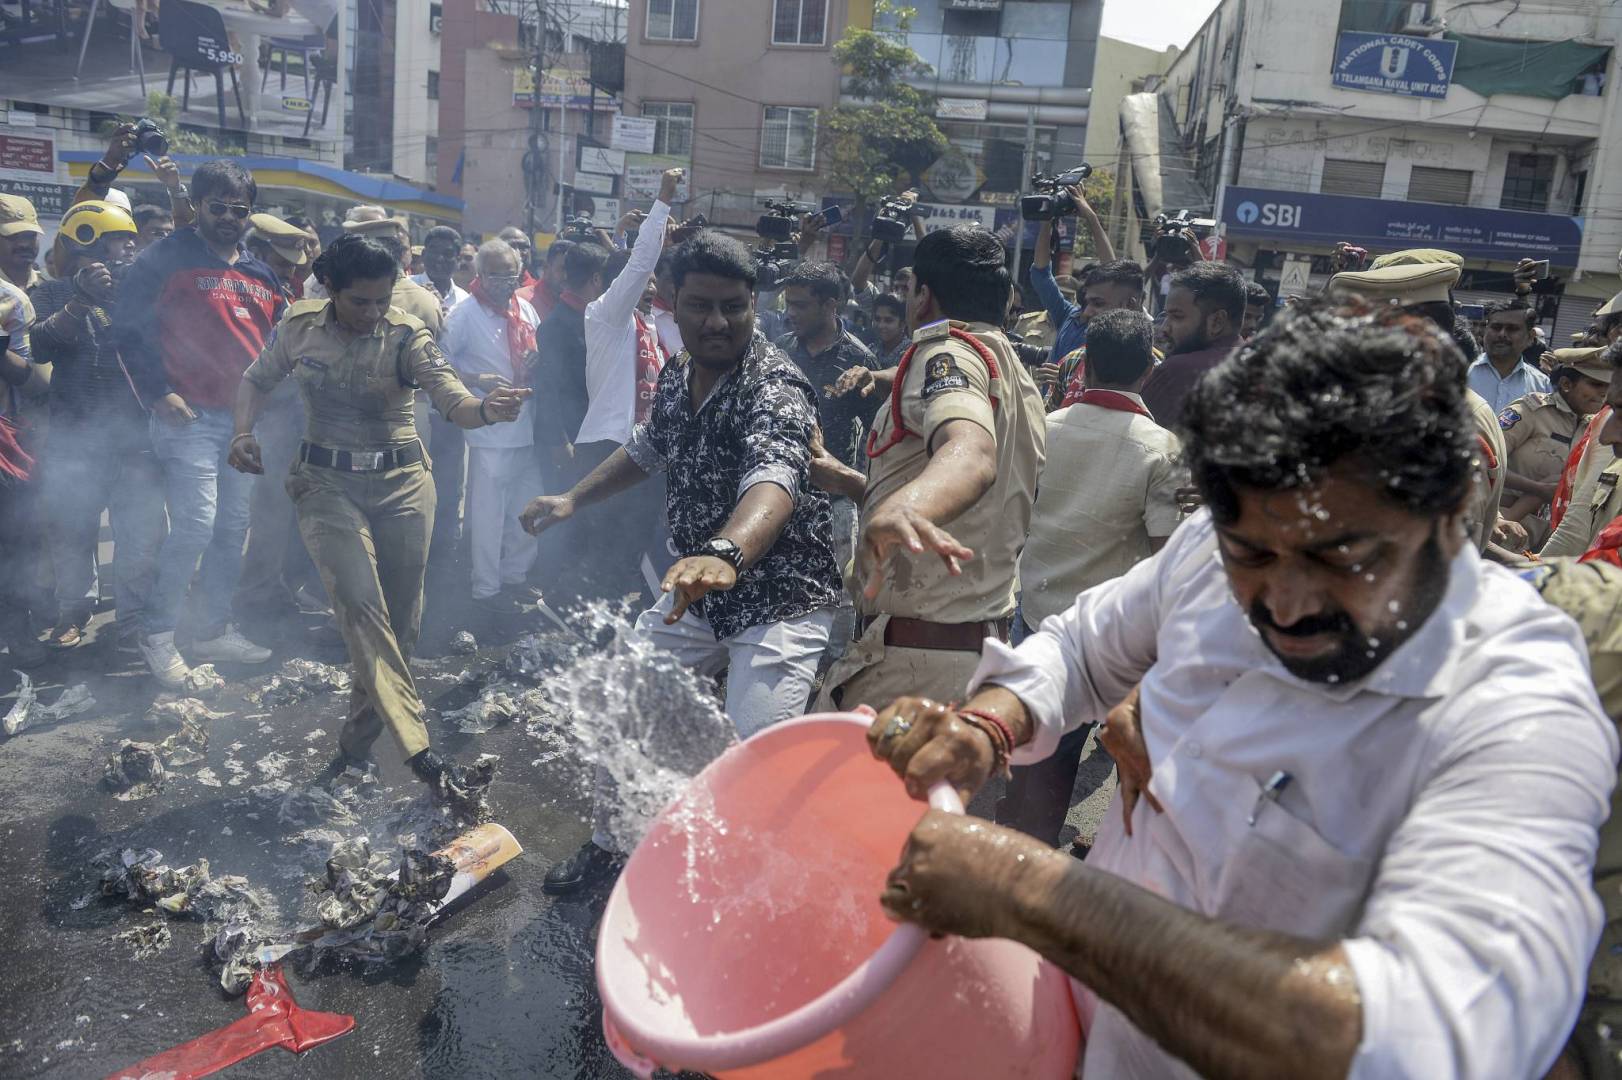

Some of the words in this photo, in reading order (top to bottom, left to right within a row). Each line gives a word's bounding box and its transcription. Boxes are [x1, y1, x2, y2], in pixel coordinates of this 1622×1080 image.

[207, 48, 243, 64] 5,950
[1339, 37, 1387, 71] NATIONAL
[1390, 37, 1424, 51] CADET
[1423, 49, 1447, 81] CORPS
[1341, 73, 1384, 87] TELANGANA
[1385, 79, 1409, 90] NAVAL
[1410, 82, 1430, 93] UNIT
[1430, 84, 1447, 94] NCC
[13, 183, 62, 194] Abroad
[41, 197, 62, 206] PTE
[1261, 203, 1302, 228] SBI
[926, 379, 963, 393] POLICE
